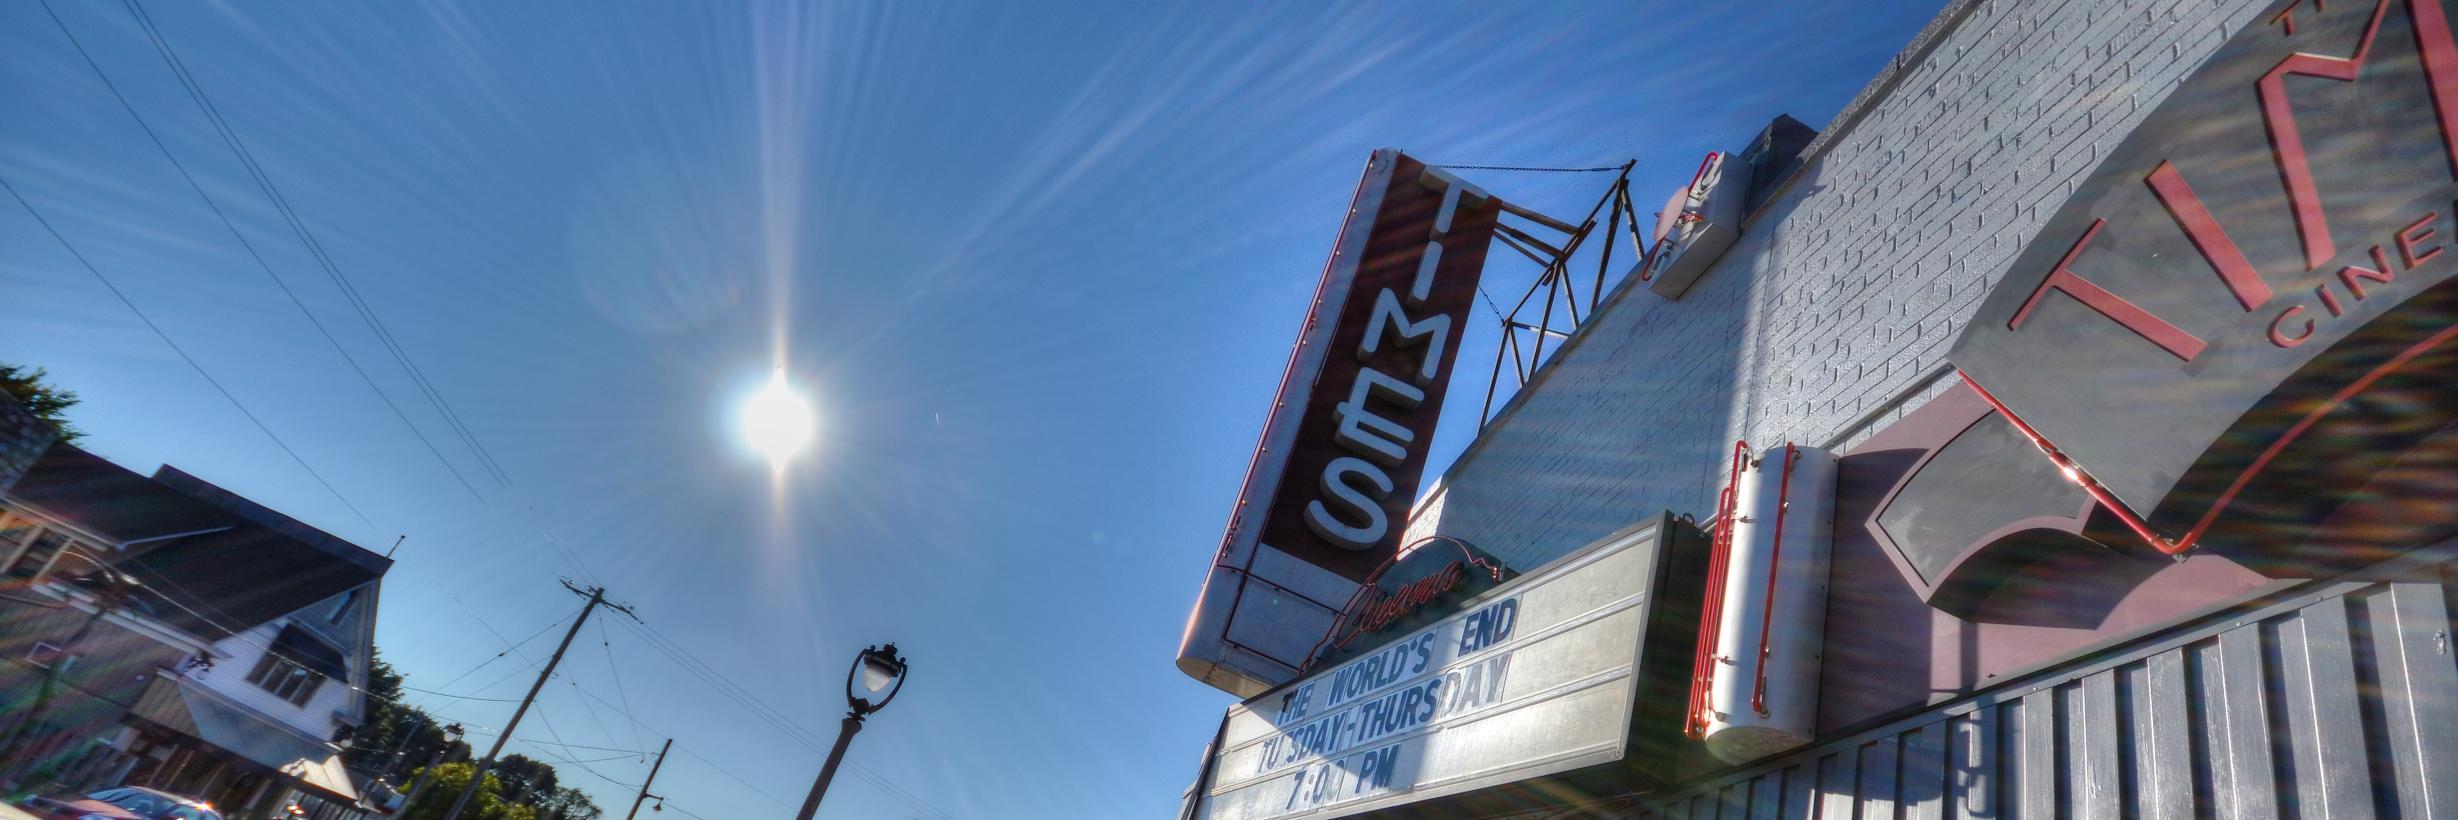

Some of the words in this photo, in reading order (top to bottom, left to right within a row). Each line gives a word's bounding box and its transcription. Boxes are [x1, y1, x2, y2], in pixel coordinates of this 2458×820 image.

[2267, 210, 2458, 348] CINE
[1303, 164, 1490, 551] TIMES
[1258, 653, 1512, 773] TUSDAY-THURSDAY
[1278, 683, 1315, 725] THE
[1328, 632, 1436, 706] WORLD'S
[1457, 598, 1518, 657] END
[1355, 744, 1400, 794] PM
